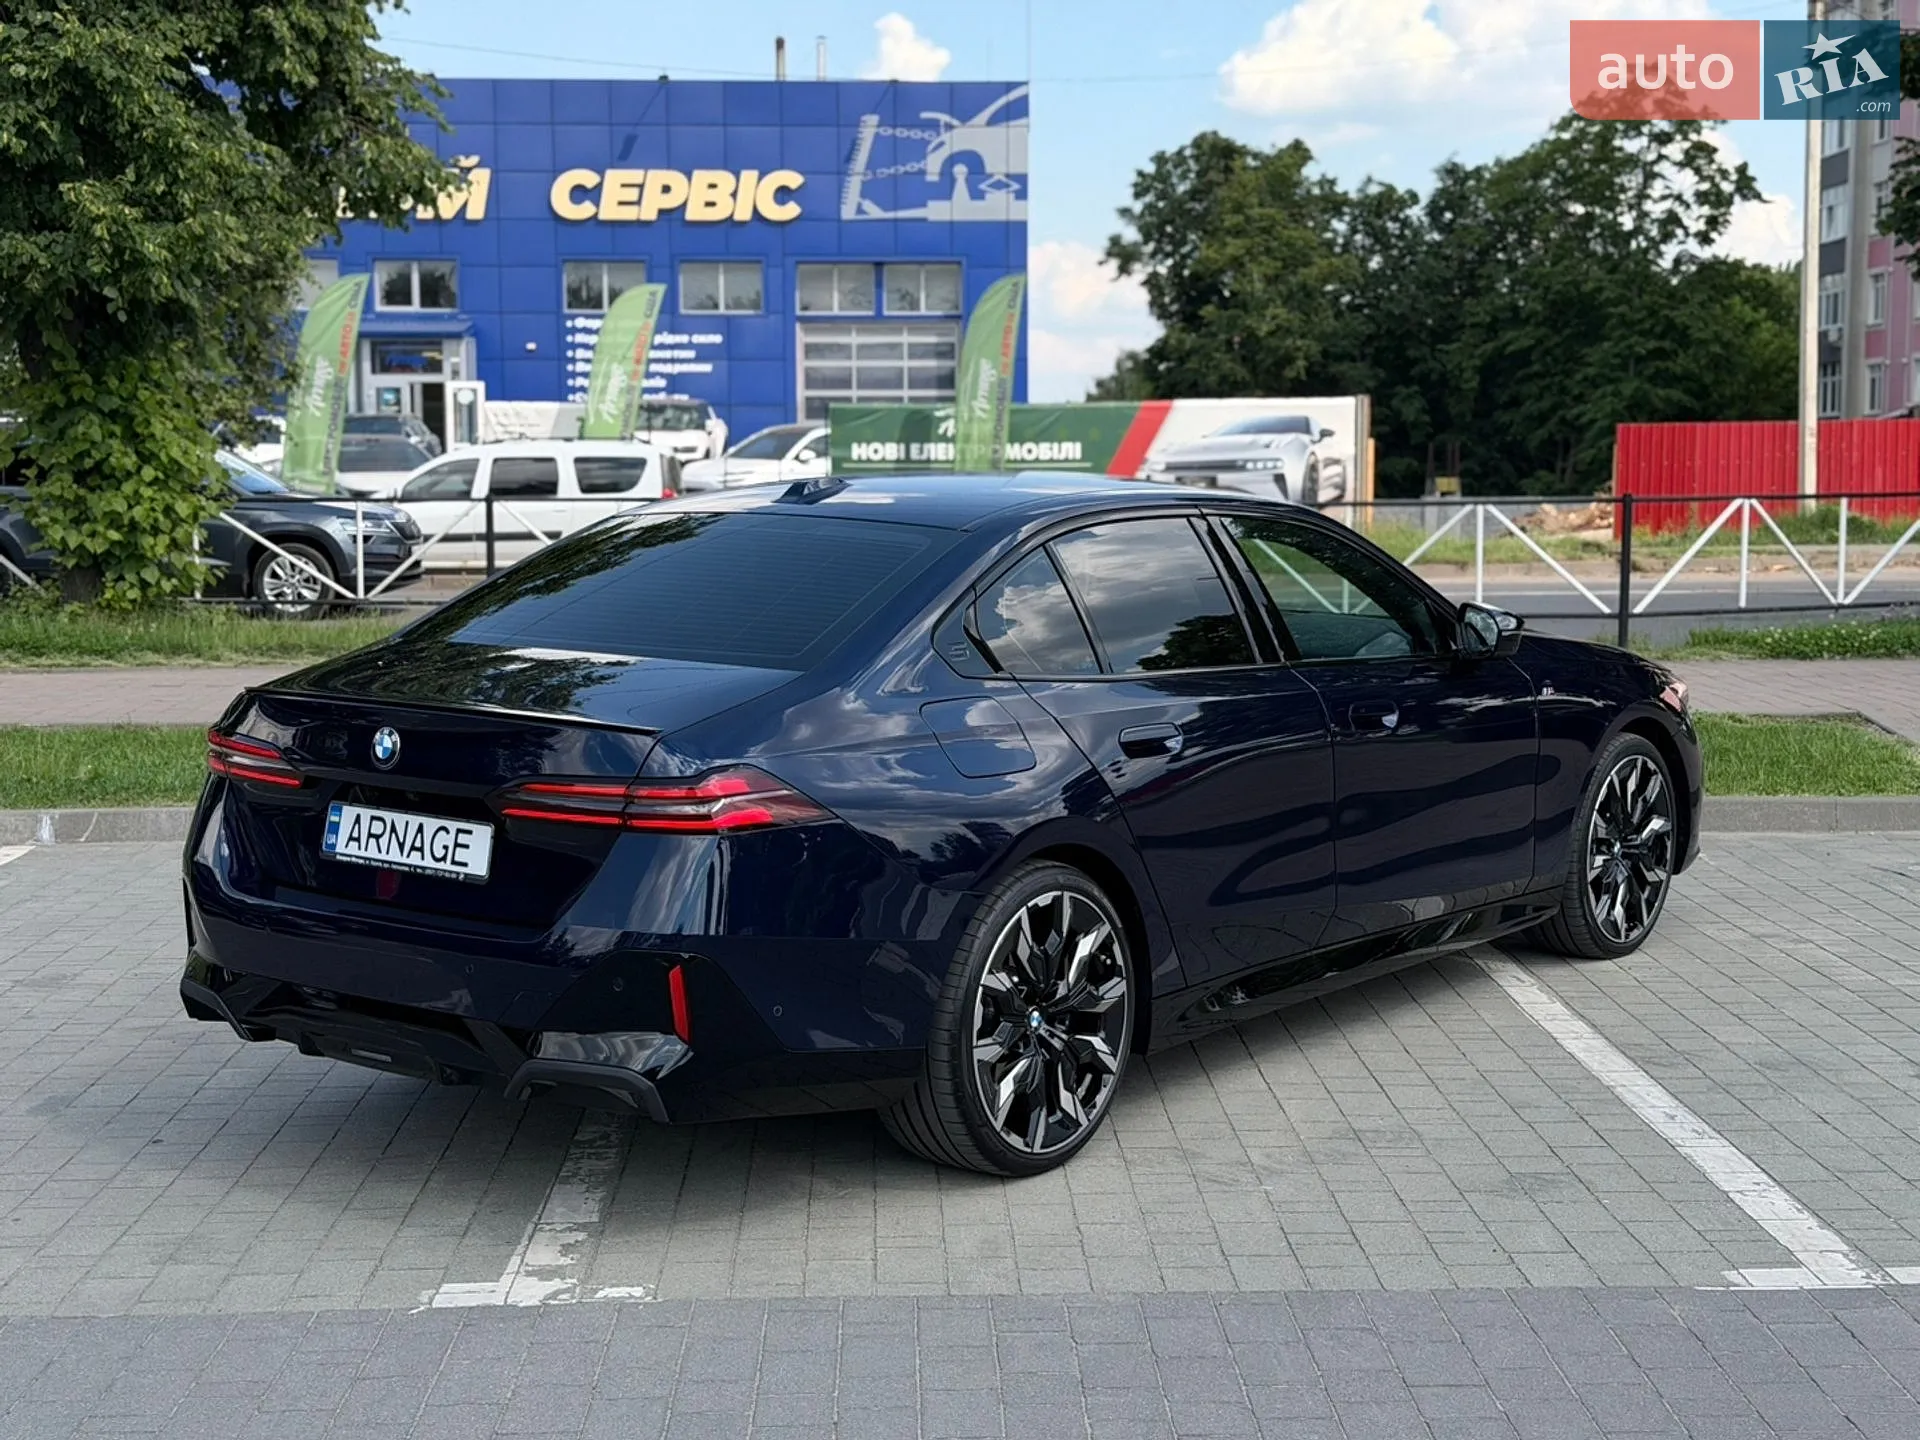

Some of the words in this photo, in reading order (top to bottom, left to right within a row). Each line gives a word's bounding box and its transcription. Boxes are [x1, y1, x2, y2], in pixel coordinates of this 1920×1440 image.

[550, 168, 806, 222] СЕРВІС
[851, 442, 906, 461] НОВІ
[345, 813, 473, 868] ARNAGE
